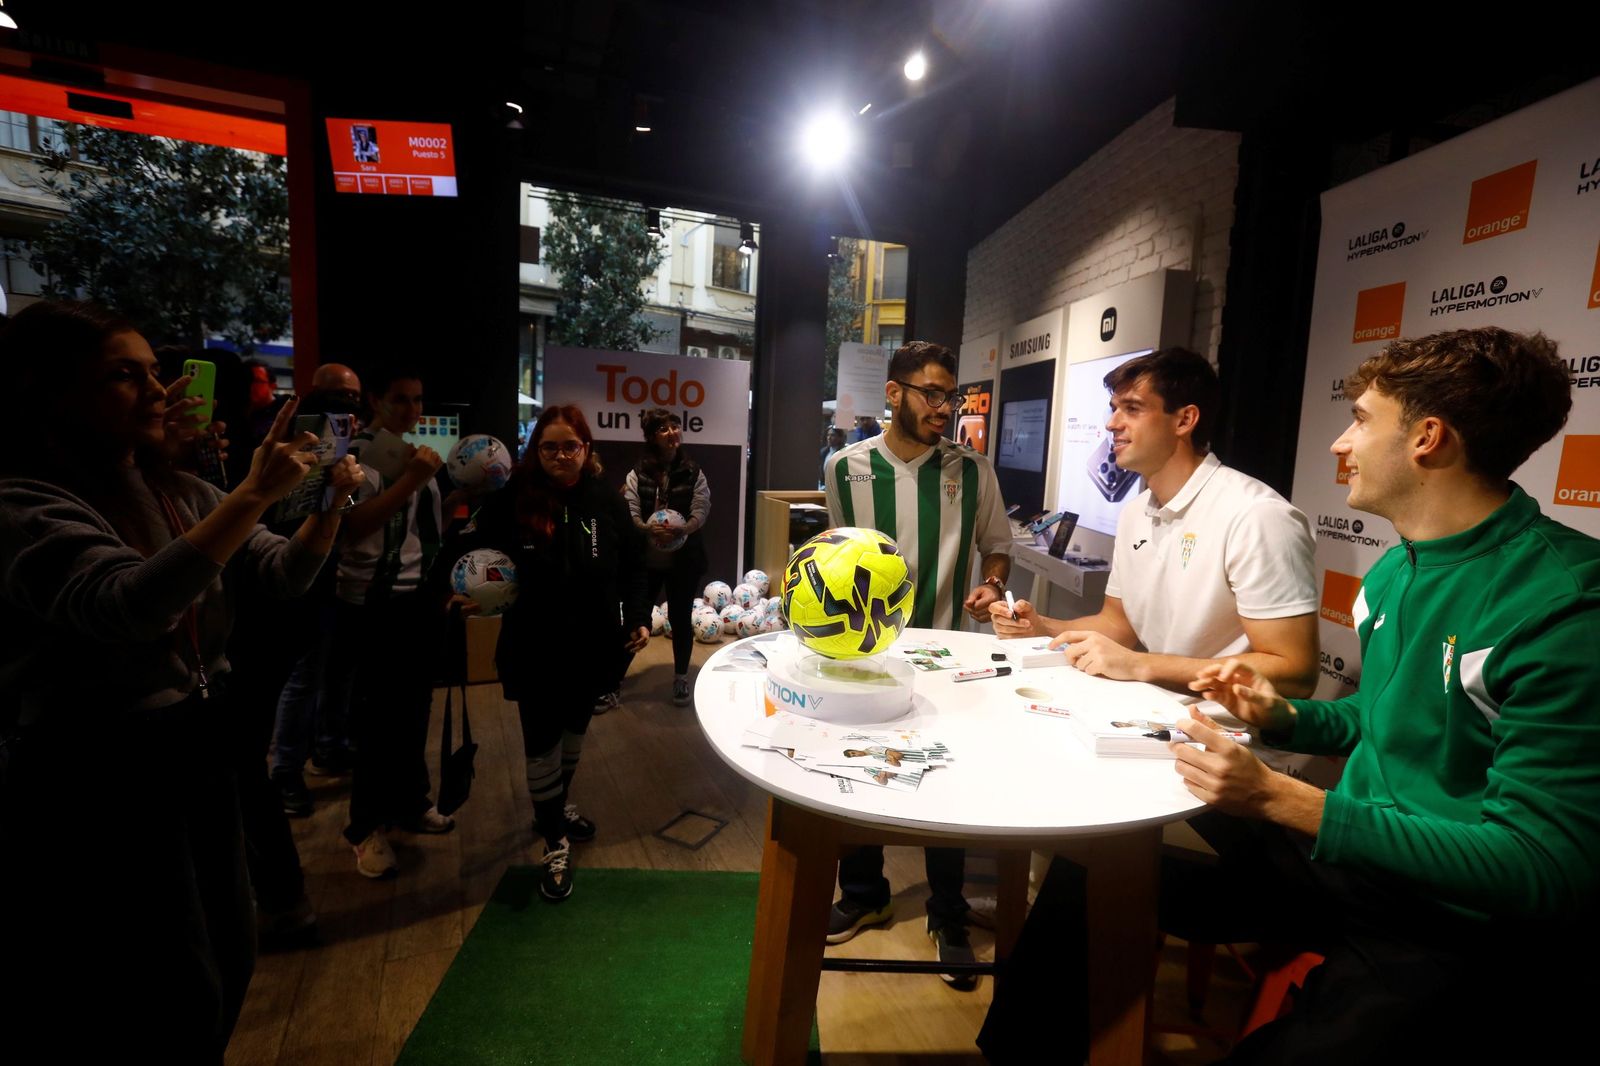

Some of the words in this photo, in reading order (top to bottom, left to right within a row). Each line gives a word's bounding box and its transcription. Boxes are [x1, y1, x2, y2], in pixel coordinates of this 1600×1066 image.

[408, 137, 447, 149] M0002
[413, 150, 439, 158] Puesto
[361, 164, 377, 172] Sara
[1467, 214, 1521, 239] orange
[1347, 233, 1420, 262] HYPERMOTION
[1349, 228, 1388, 250] LALIGA
[1432, 281, 1485, 304] LALIGA
[1430, 290, 1530, 316] HYPERMOTION
[1354, 324, 1395, 340] orange
[1010, 332, 1051, 359] SAMSUNG
[596, 364, 705, 408] Todo
[598, 411, 630, 430] un
[844, 474, 877, 482] Kappa
[1318, 515, 1349, 530] LALIGA
[1316, 528, 1380, 548] HYPERMOTION
[1322, 606, 1354, 624] orange
